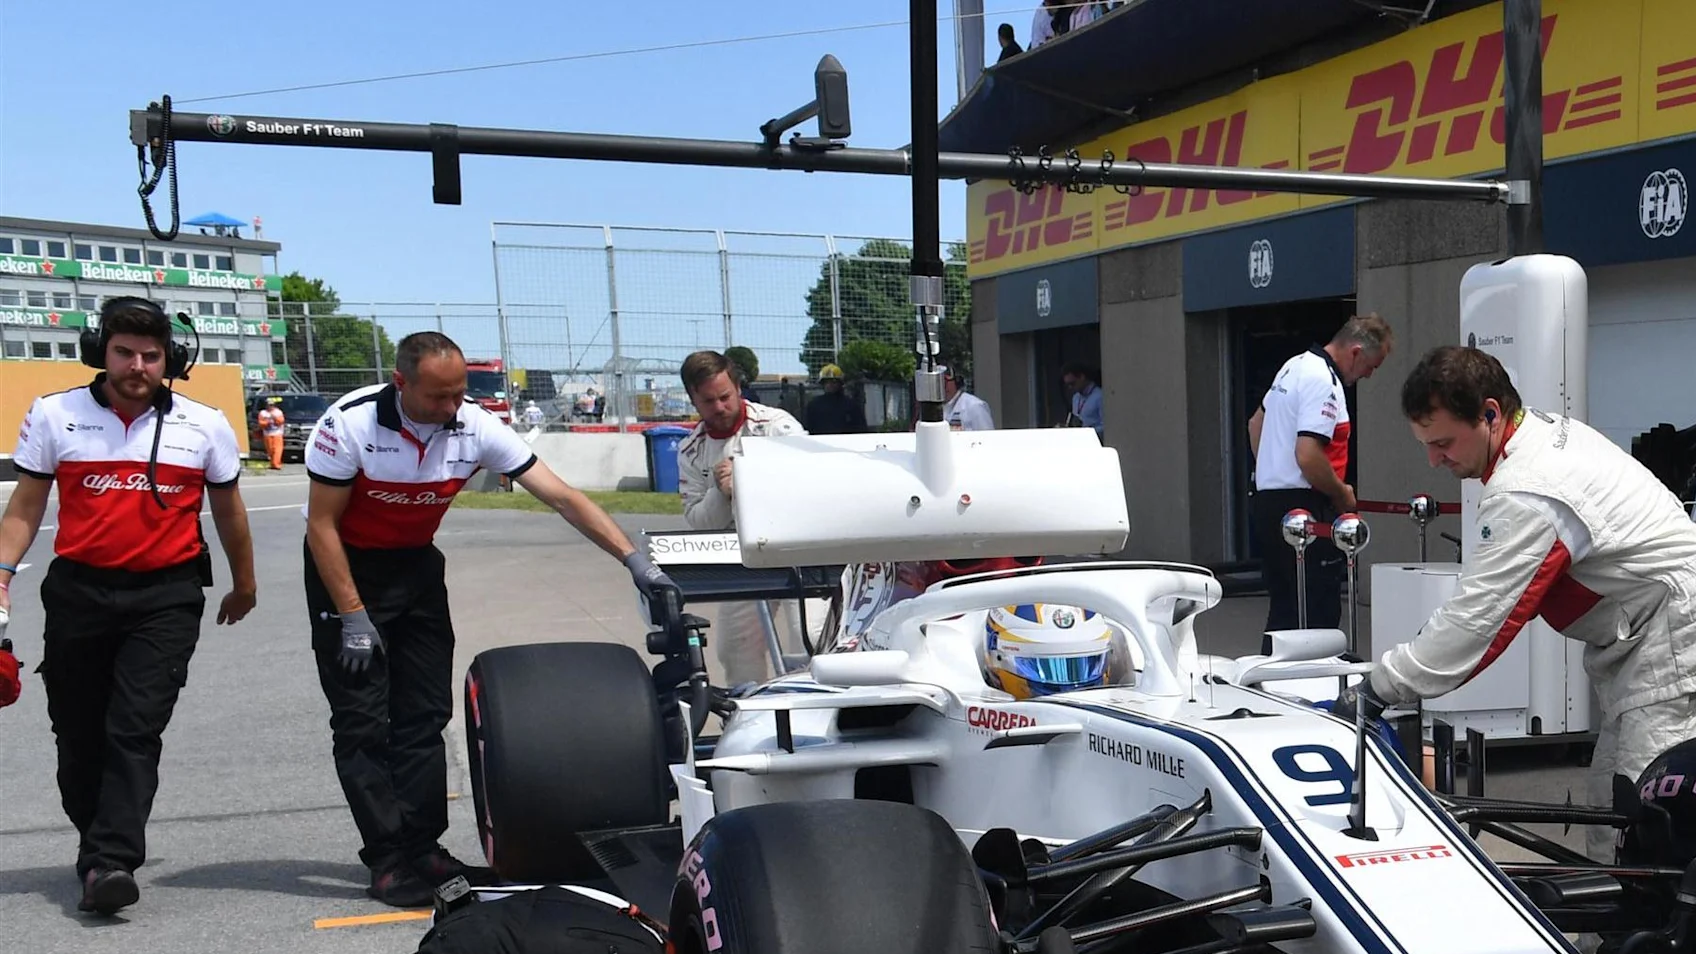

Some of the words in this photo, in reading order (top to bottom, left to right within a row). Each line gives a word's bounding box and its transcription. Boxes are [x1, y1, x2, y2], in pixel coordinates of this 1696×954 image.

[246, 120, 300, 136] Sauber
[325, 124, 365, 138] Team
[1125, 109, 1253, 227] DHL
[984, 179, 1075, 261] DHL
[81, 261, 153, 283] Heineken
[188, 271, 251, 290] Heineken
[194, 319, 257, 336] Heineen
[83, 473, 122, 496] Alfa
[412, 490, 451, 505] Rom
[656, 535, 740, 554] Schweiz
[1088, 733, 1142, 766] RICHARD
[1146, 750, 1185, 779] MILLE
[1271, 743, 1356, 807] 9
[1333, 845, 1453, 869] PIRELLI
